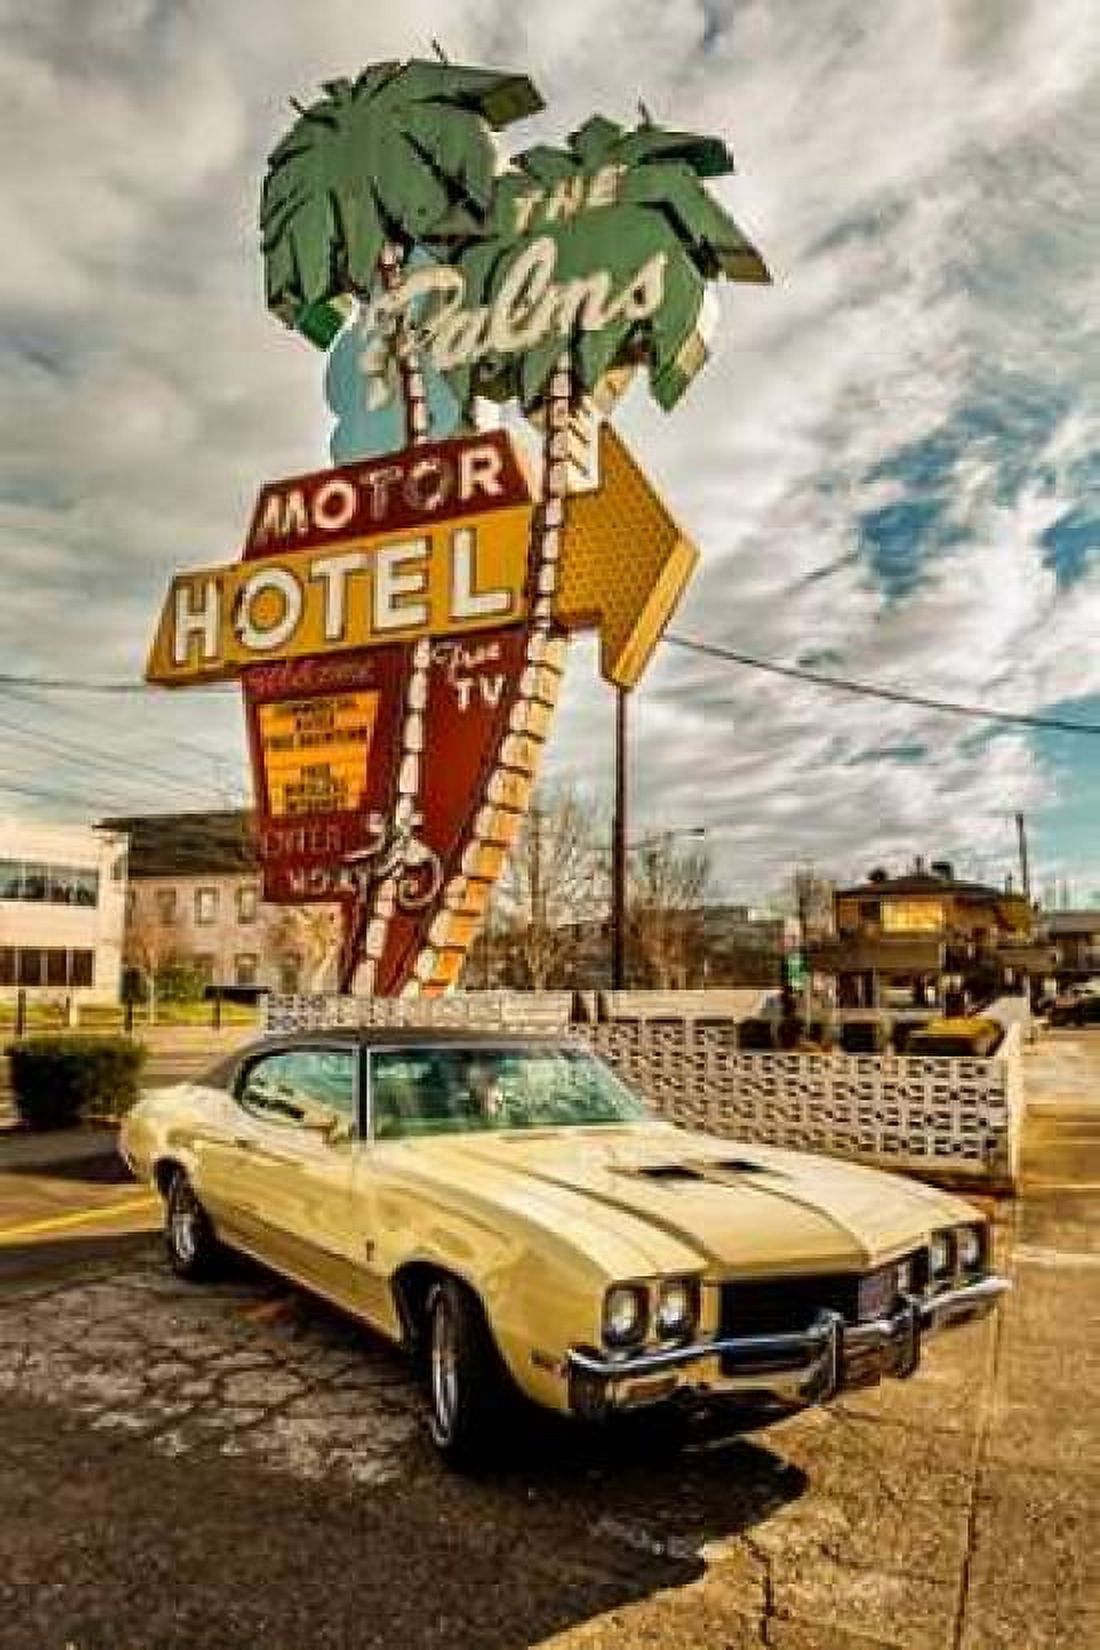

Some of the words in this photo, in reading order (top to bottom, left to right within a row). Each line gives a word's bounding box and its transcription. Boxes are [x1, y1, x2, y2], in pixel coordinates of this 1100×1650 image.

[513, 164, 630, 234] THE
[359, 236, 668, 411] Palms
[262, 444, 505, 537] MOTOR
[173, 525, 512, 666] HOTEL
[456, 673, 505, 713] TV
